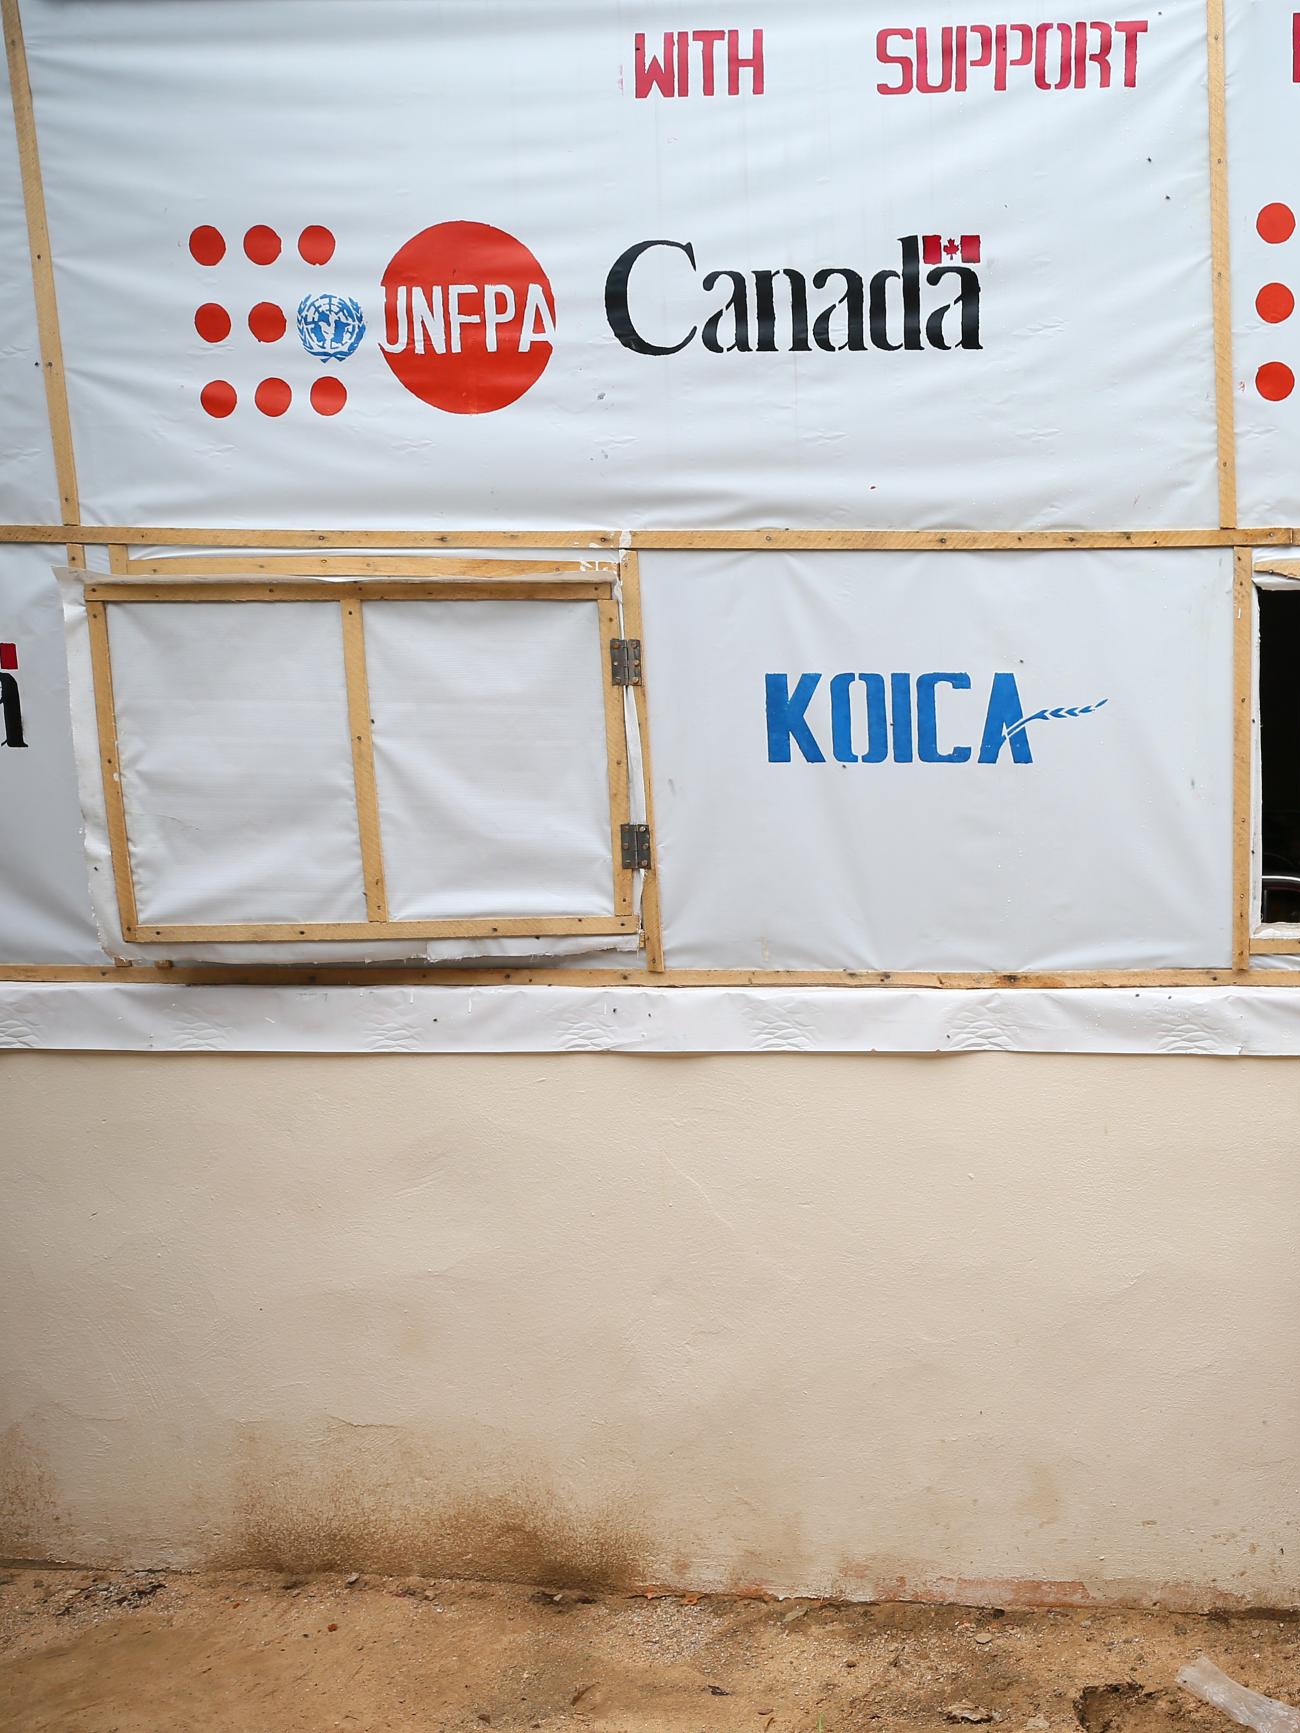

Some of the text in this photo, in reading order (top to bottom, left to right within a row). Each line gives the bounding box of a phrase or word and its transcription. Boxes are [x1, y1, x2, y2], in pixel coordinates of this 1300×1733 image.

[635, 29, 764, 99] WITH
[876, 20, 1149, 95] SUPPORT
[378, 282, 557, 355] UNFPA
[604, 234, 984, 357] Canada
[764, 671, 1034, 765] KOICA
